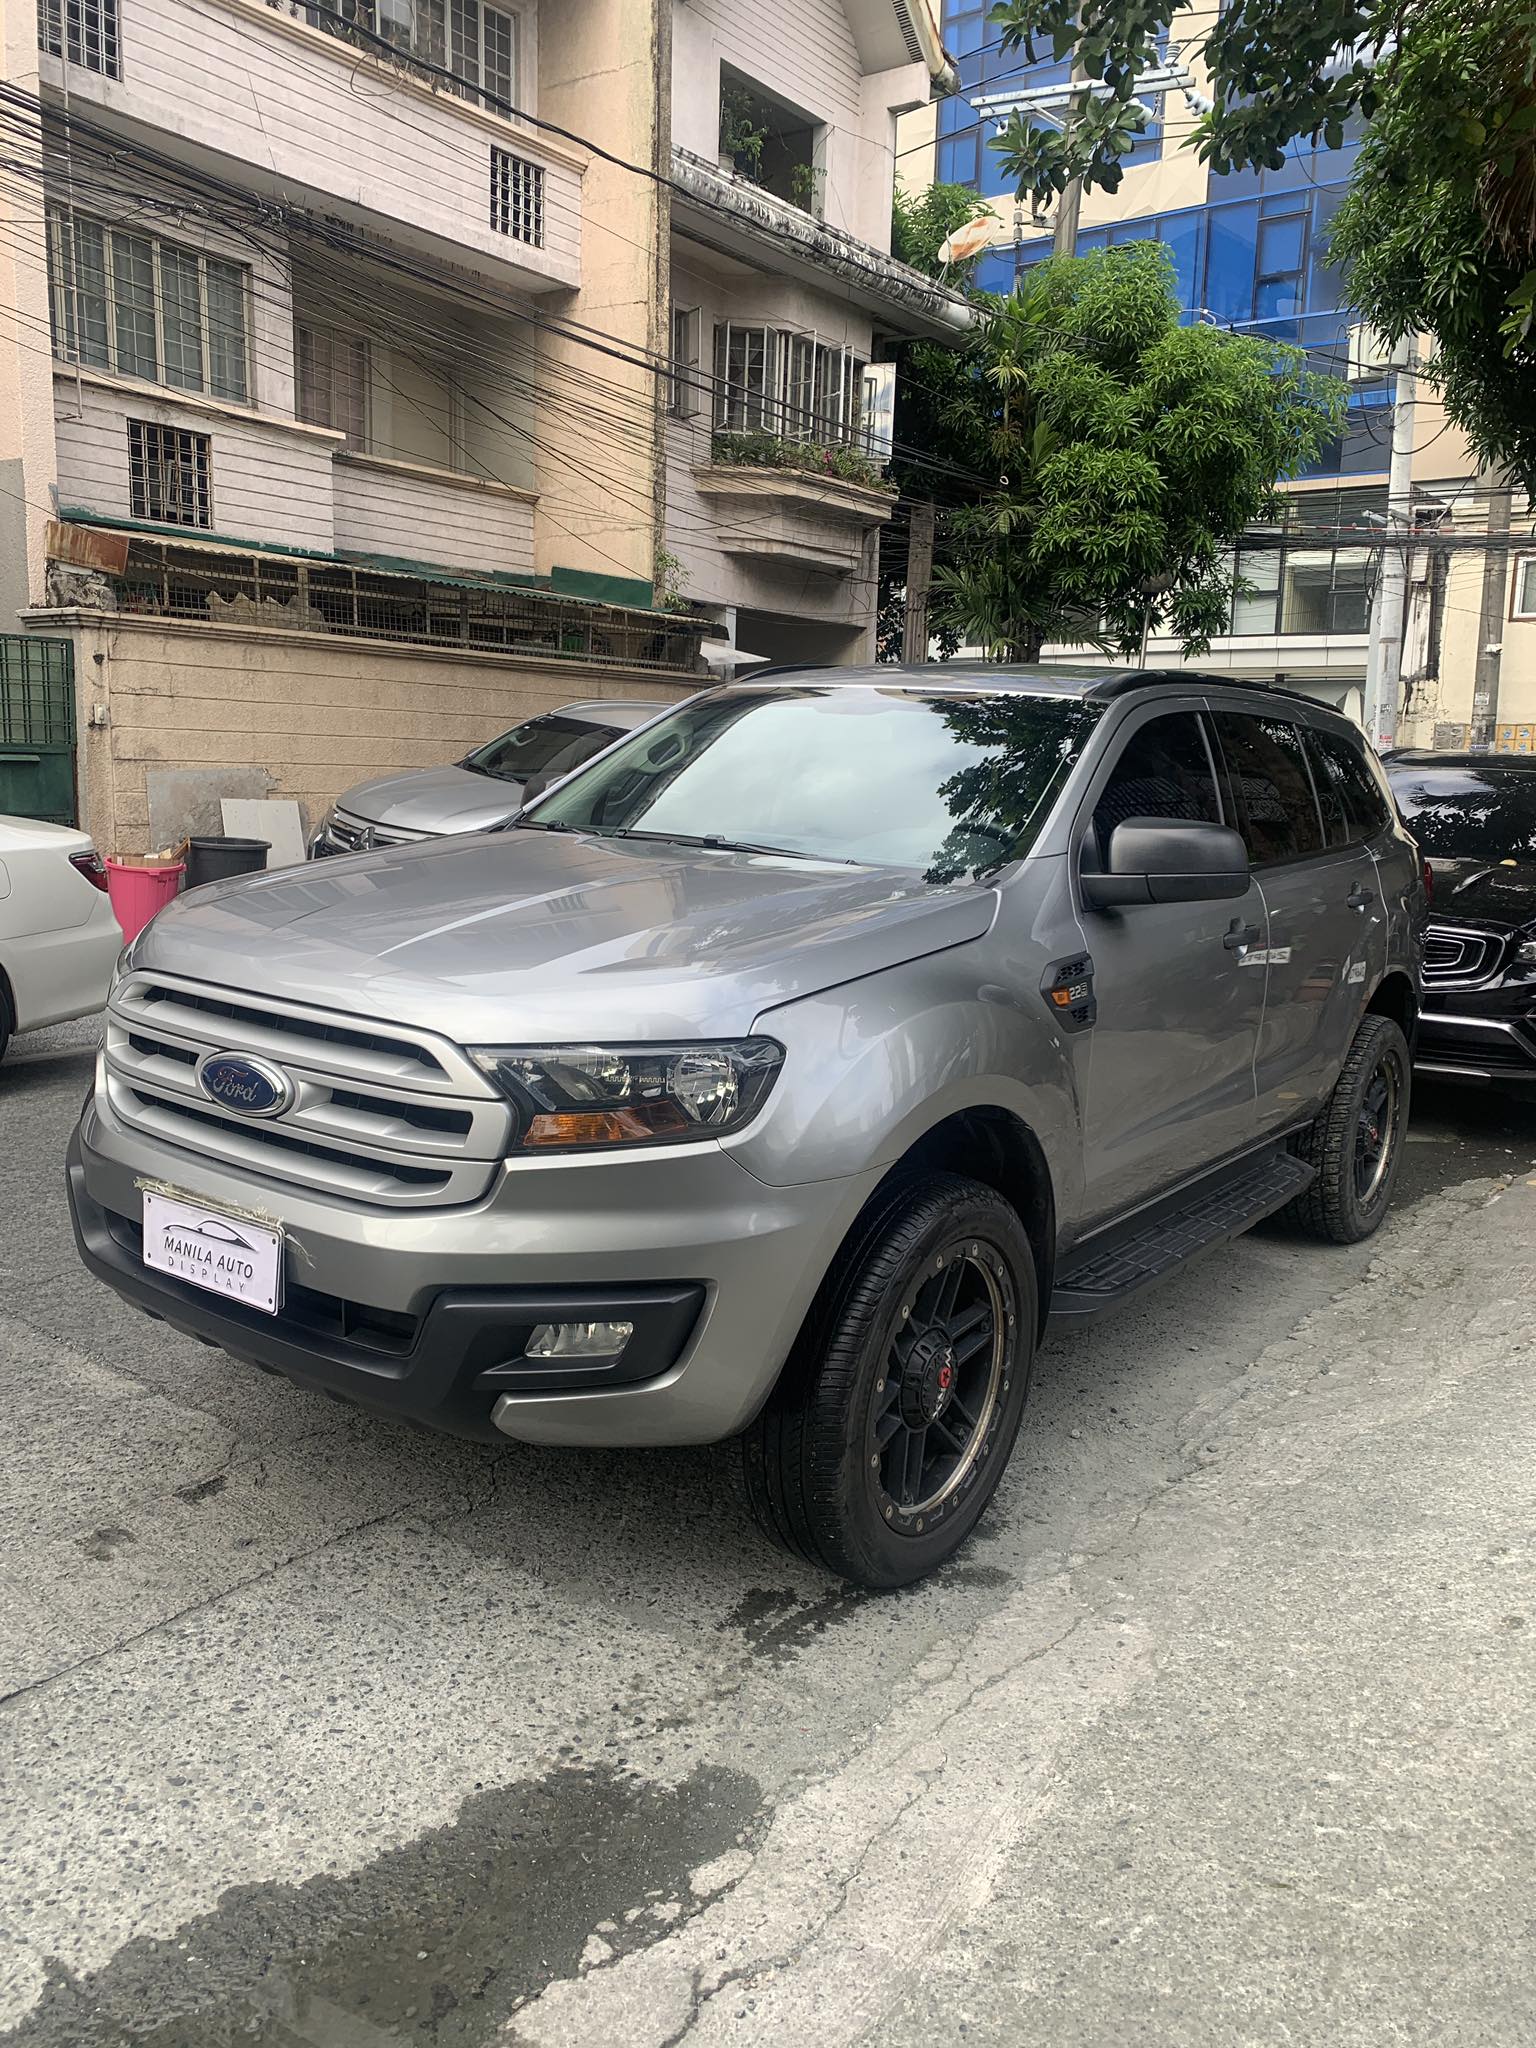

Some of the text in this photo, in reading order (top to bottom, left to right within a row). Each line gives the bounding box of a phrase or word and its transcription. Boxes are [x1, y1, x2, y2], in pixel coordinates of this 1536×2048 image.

[213, 1066, 259, 1102] Ford
[163, 1235, 254, 1280] MANILA AUTO
[167, 1255, 246, 1294] DISPLAY
